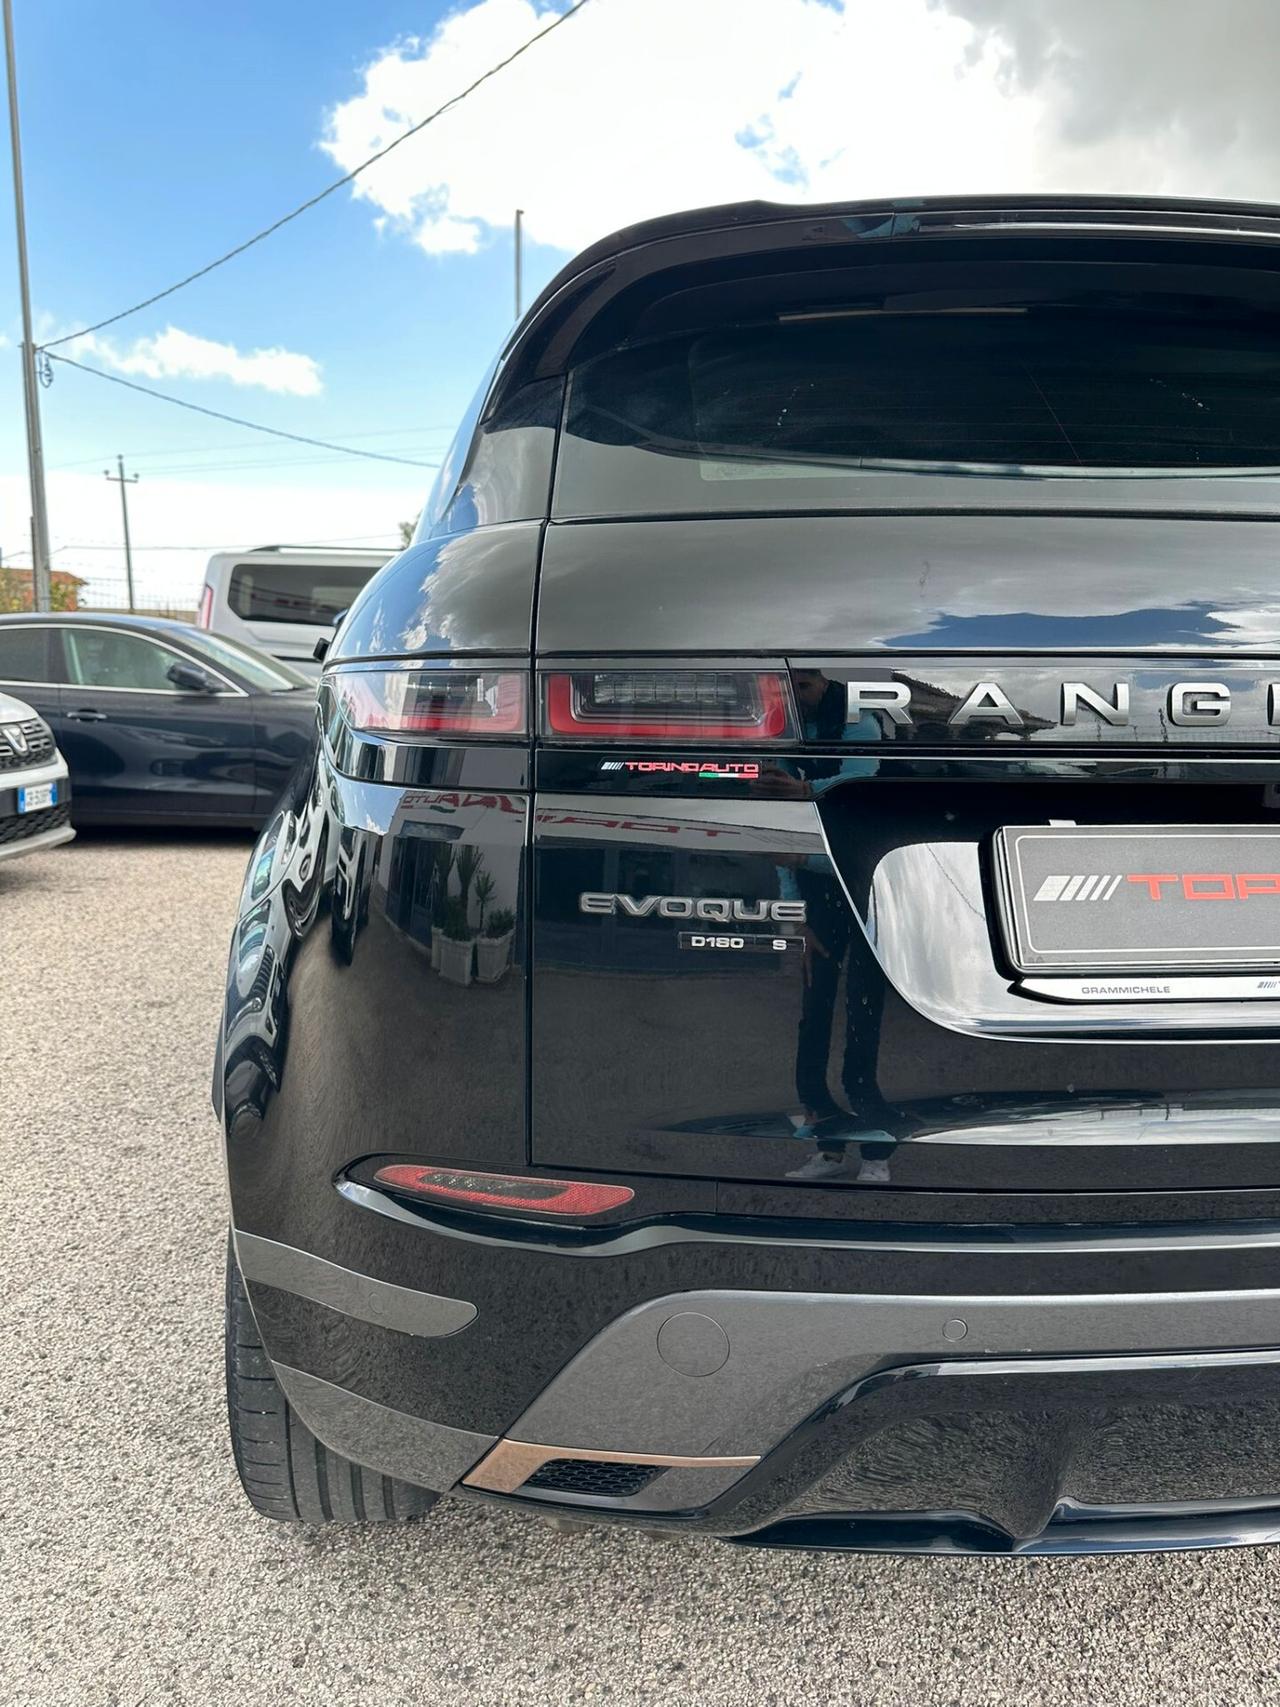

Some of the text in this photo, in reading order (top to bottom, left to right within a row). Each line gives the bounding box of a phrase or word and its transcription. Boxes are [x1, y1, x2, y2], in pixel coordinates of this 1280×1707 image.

[846, 681, 1280, 726] RANG
[624, 762, 759, 773] TORINOAUTO
[579, 892, 806, 922] EVOQUE
[691, 936, 788, 951] D180 S
[1081, 986, 1171, 995] GRAMMICHELE
